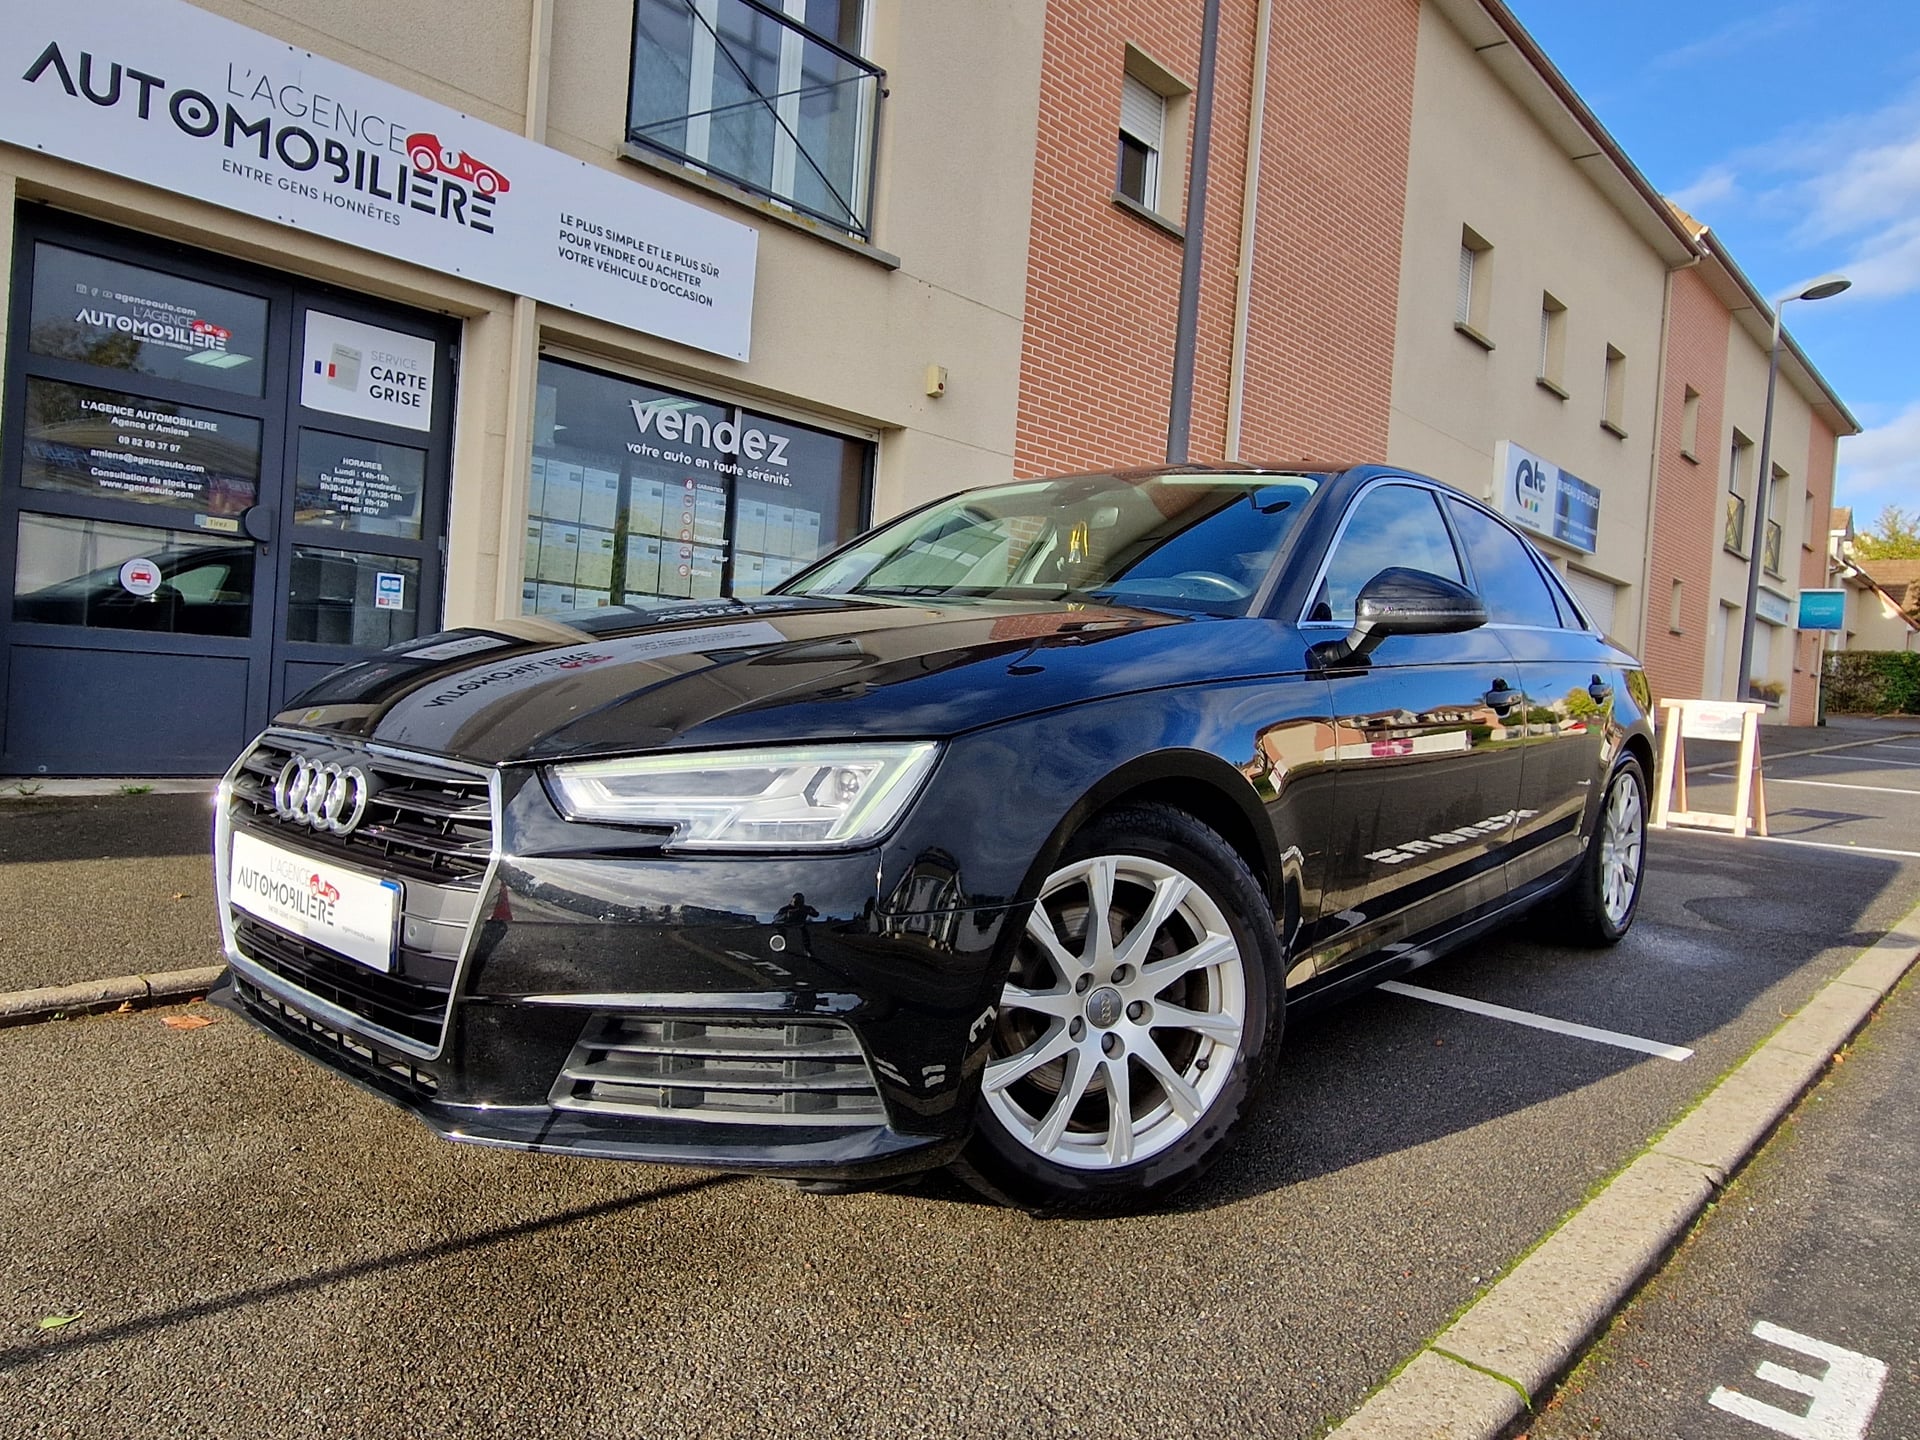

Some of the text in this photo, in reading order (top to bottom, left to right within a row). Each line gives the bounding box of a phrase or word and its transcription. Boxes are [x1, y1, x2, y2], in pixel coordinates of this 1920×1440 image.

[227, 62, 406, 155] L'AGENCE
[222, 159, 401, 226] ENTRE GENS HONNÊTES
[560, 213, 720, 278] LE PLUS SIMPLE ET LE PLUS SÛR
[559, 229, 701, 287] POUR VENDRE OU ACHETER
[558, 246, 713, 307] VOTRE VÉHICULE D'OCCASION
[133, 306, 194, 328] L'AGENCE
[370, 351, 417, 370] SERVICE
[370, 366, 427, 391] CARTE
[369, 385, 421, 408] GRISE
[81, 400, 218, 432] L'AGENCE AUTOMOBILIERE
[111, 416, 189, 437] Agence d'Amiens
[629, 400, 790, 466] vendez
[334, 467, 356, 477] Lundi
[342, 457, 382, 470] HORAIRES
[626, 442, 792, 487] votre auto en toute sérénité.
[91, 467, 202, 491] Consultation du stock sur
[320, 473, 332, 481] Du
[332, 476, 354, 485] mardi
[363, 506, 380, 516] RDV
